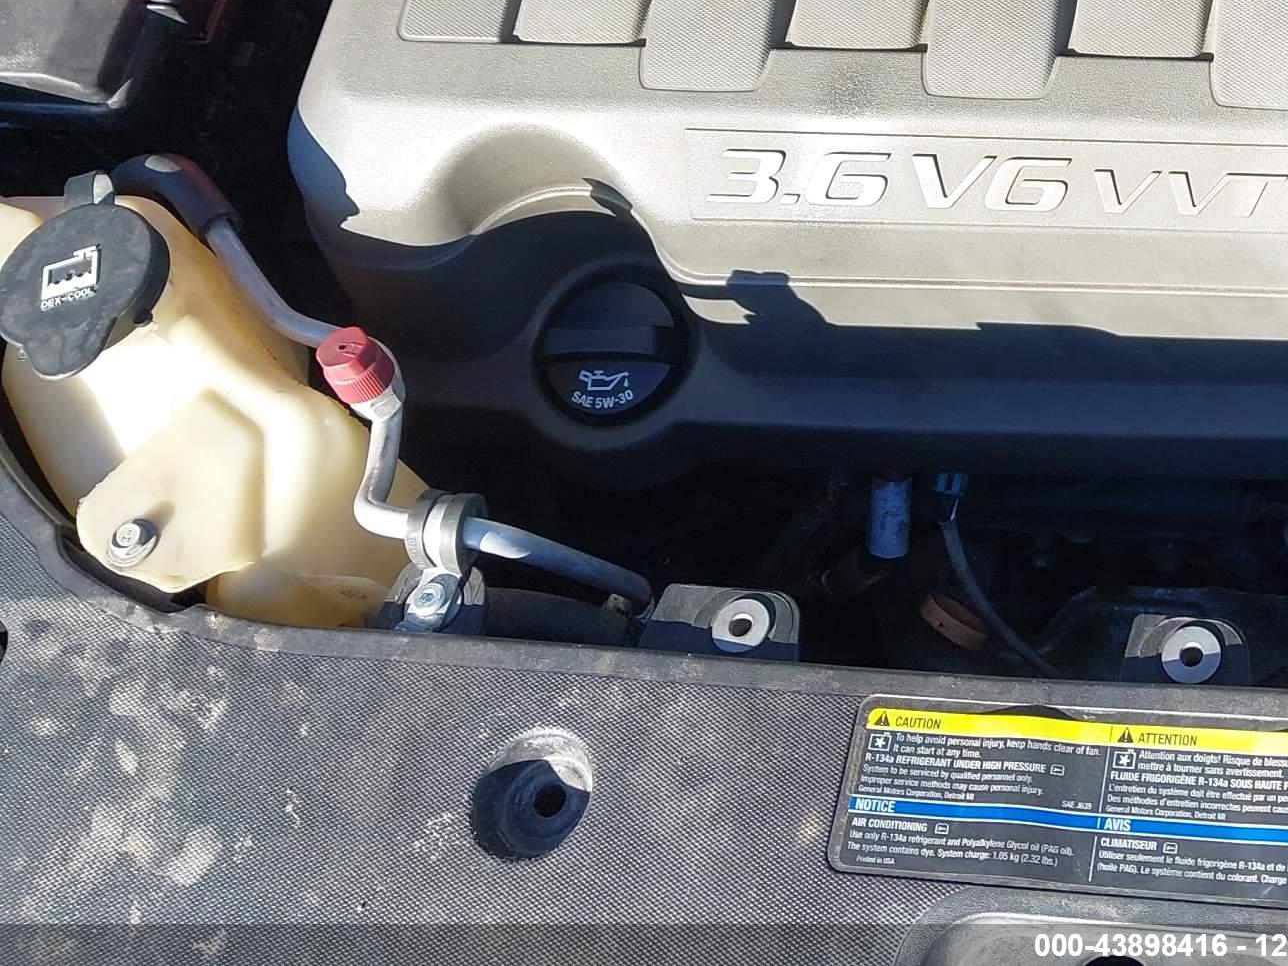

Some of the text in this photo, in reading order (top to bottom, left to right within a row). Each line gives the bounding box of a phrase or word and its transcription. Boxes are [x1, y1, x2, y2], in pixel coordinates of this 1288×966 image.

[707, 148, 891, 207] 3.6
[911, 153, 1073, 212] V6
[41, 287, 96, 311] DEX-COOL
[571, 389, 634, 409] SAE 5W-30
[895, 716, 941, 729] CAUTION
[896, 733, 904, 742] To
[906, 734, 922, 744] help
[925, 735, 945, 744] avoid
[947, 737, 981, 747] personal
[1006, 739, 1026, 750] keep
[1027, 740, 1051, 751] hands
[1053, 743, 1073, 754] clear
[1075, 745, 1084, 754] of
[1086, 746, 1101, 756] fan.
[1138, 733, 1197, 746] ATTENTION
[893, 744, 981, 758] It can start at any time.
[1139, 750, 1175, 761] Attention
[1177, 753, 1192, 762] aux
[1193, 753, 1221, 765] doigts!
[1222, 755, 1250, 767] Risque
[1252, 757, 1262, 766] de
[865, 753, 1046, 773] R-134a REFRIGERANT UNDER HIGH PRESSURE
[1137, 762, 1164, 771] mettre
[1173, 764, 1203, 774] tourner
[1204, 767, 1224, 775] sans
[1225, 767, 1284, 778] avertissement.
[863, 764, 889, 775] System
[899, 767, 908, 775] be
[910, 768, 939, 778] serviced
[940, 770, 949, 780] by
[950, 771, 980, 781] qualified
[981, 774, 1015, 783] personnel
[1016, 775, 1032, 785] only.
[1110, 771, 1140, 782] FLUIDE
[1198, 777, 1229, 787] R-134a
[1230, 778, 1253, 789] SOUS
[1254, 780, 1282, 790] HAUTE
[858, 785, 882, 793] General
[884, 786, 904, 795] Motors
[944, 791, 964, 800] Detroit
[861, 775, 1043, 796] Improper service methods may cause personal injury.
[1147, 786, 1157, 794] du
[1190, 789, 1204, 798] doit
[1253, 794, 1265, 802] par
[1266, 794, 1276, 802] un
[855, 798, 896, 812] NOTICE
[1062, 800, 1075, 809] SAE
[1106, 805, 1130, 813] General
[1131, 806, 1153, 815] Motors
[1194, 811, 1216, 820] Detroit
[1107, 794, 1121, 803] Des
[1200, 801, 1241, 811] incorrectes
[1242, 804, 1271, 813] peuvent
[851, 817, 928, 832] AIR CONDITIONING
[1104, 818, 1131, 831] AVIS
[849, 829, 863, 838] Use
[864, 831, 880, 841] only
[881, 832, 907, 842] R-134a
[908, 835, 946, 846] refrigerant
[947, 838, 960, 846] and
[961, 837, 1005, 849] Polyalkylene
[1006, 840, 1029, 850] Glycol
[1030, 843, 1039, 851] oil
[1041, 843, 1059, 854] (PAG
[1100, 837, 1158, 851] CLIMATISEUR
[848, 841, 861, 850] The
[861, 843, 887, 854] system
[889, 845, 919, 855] contains
[920, 848, 935, 857] dye.
[936, 848, 963, 859] System
[964, 850, 990, 861] charge:
[992, 851, 1008, 861] 1.05
[1009, 852, 1020, 863] kg
[1020, 854, 1041, 864] (2.32
[1099, 850, 1124, 859] Utiliser
[1125, 853, 1164, 863] seulement
[1166, 856, 1173, 864] le
[1174, 856, 1195, 866] fluide
[1238, 860, 1265, 871] R-134a
[1266, 863, 1275, 871] et
[1275, 863, 1286, 872] de
[1097, 862, 1118, 872] (huile
[1140, 866, 1150, 874] Le
[1184, 870, 1214, 879] contient
[1215, 872, 1226, 881] du
[1260, 874, 1287, 886] Charge
